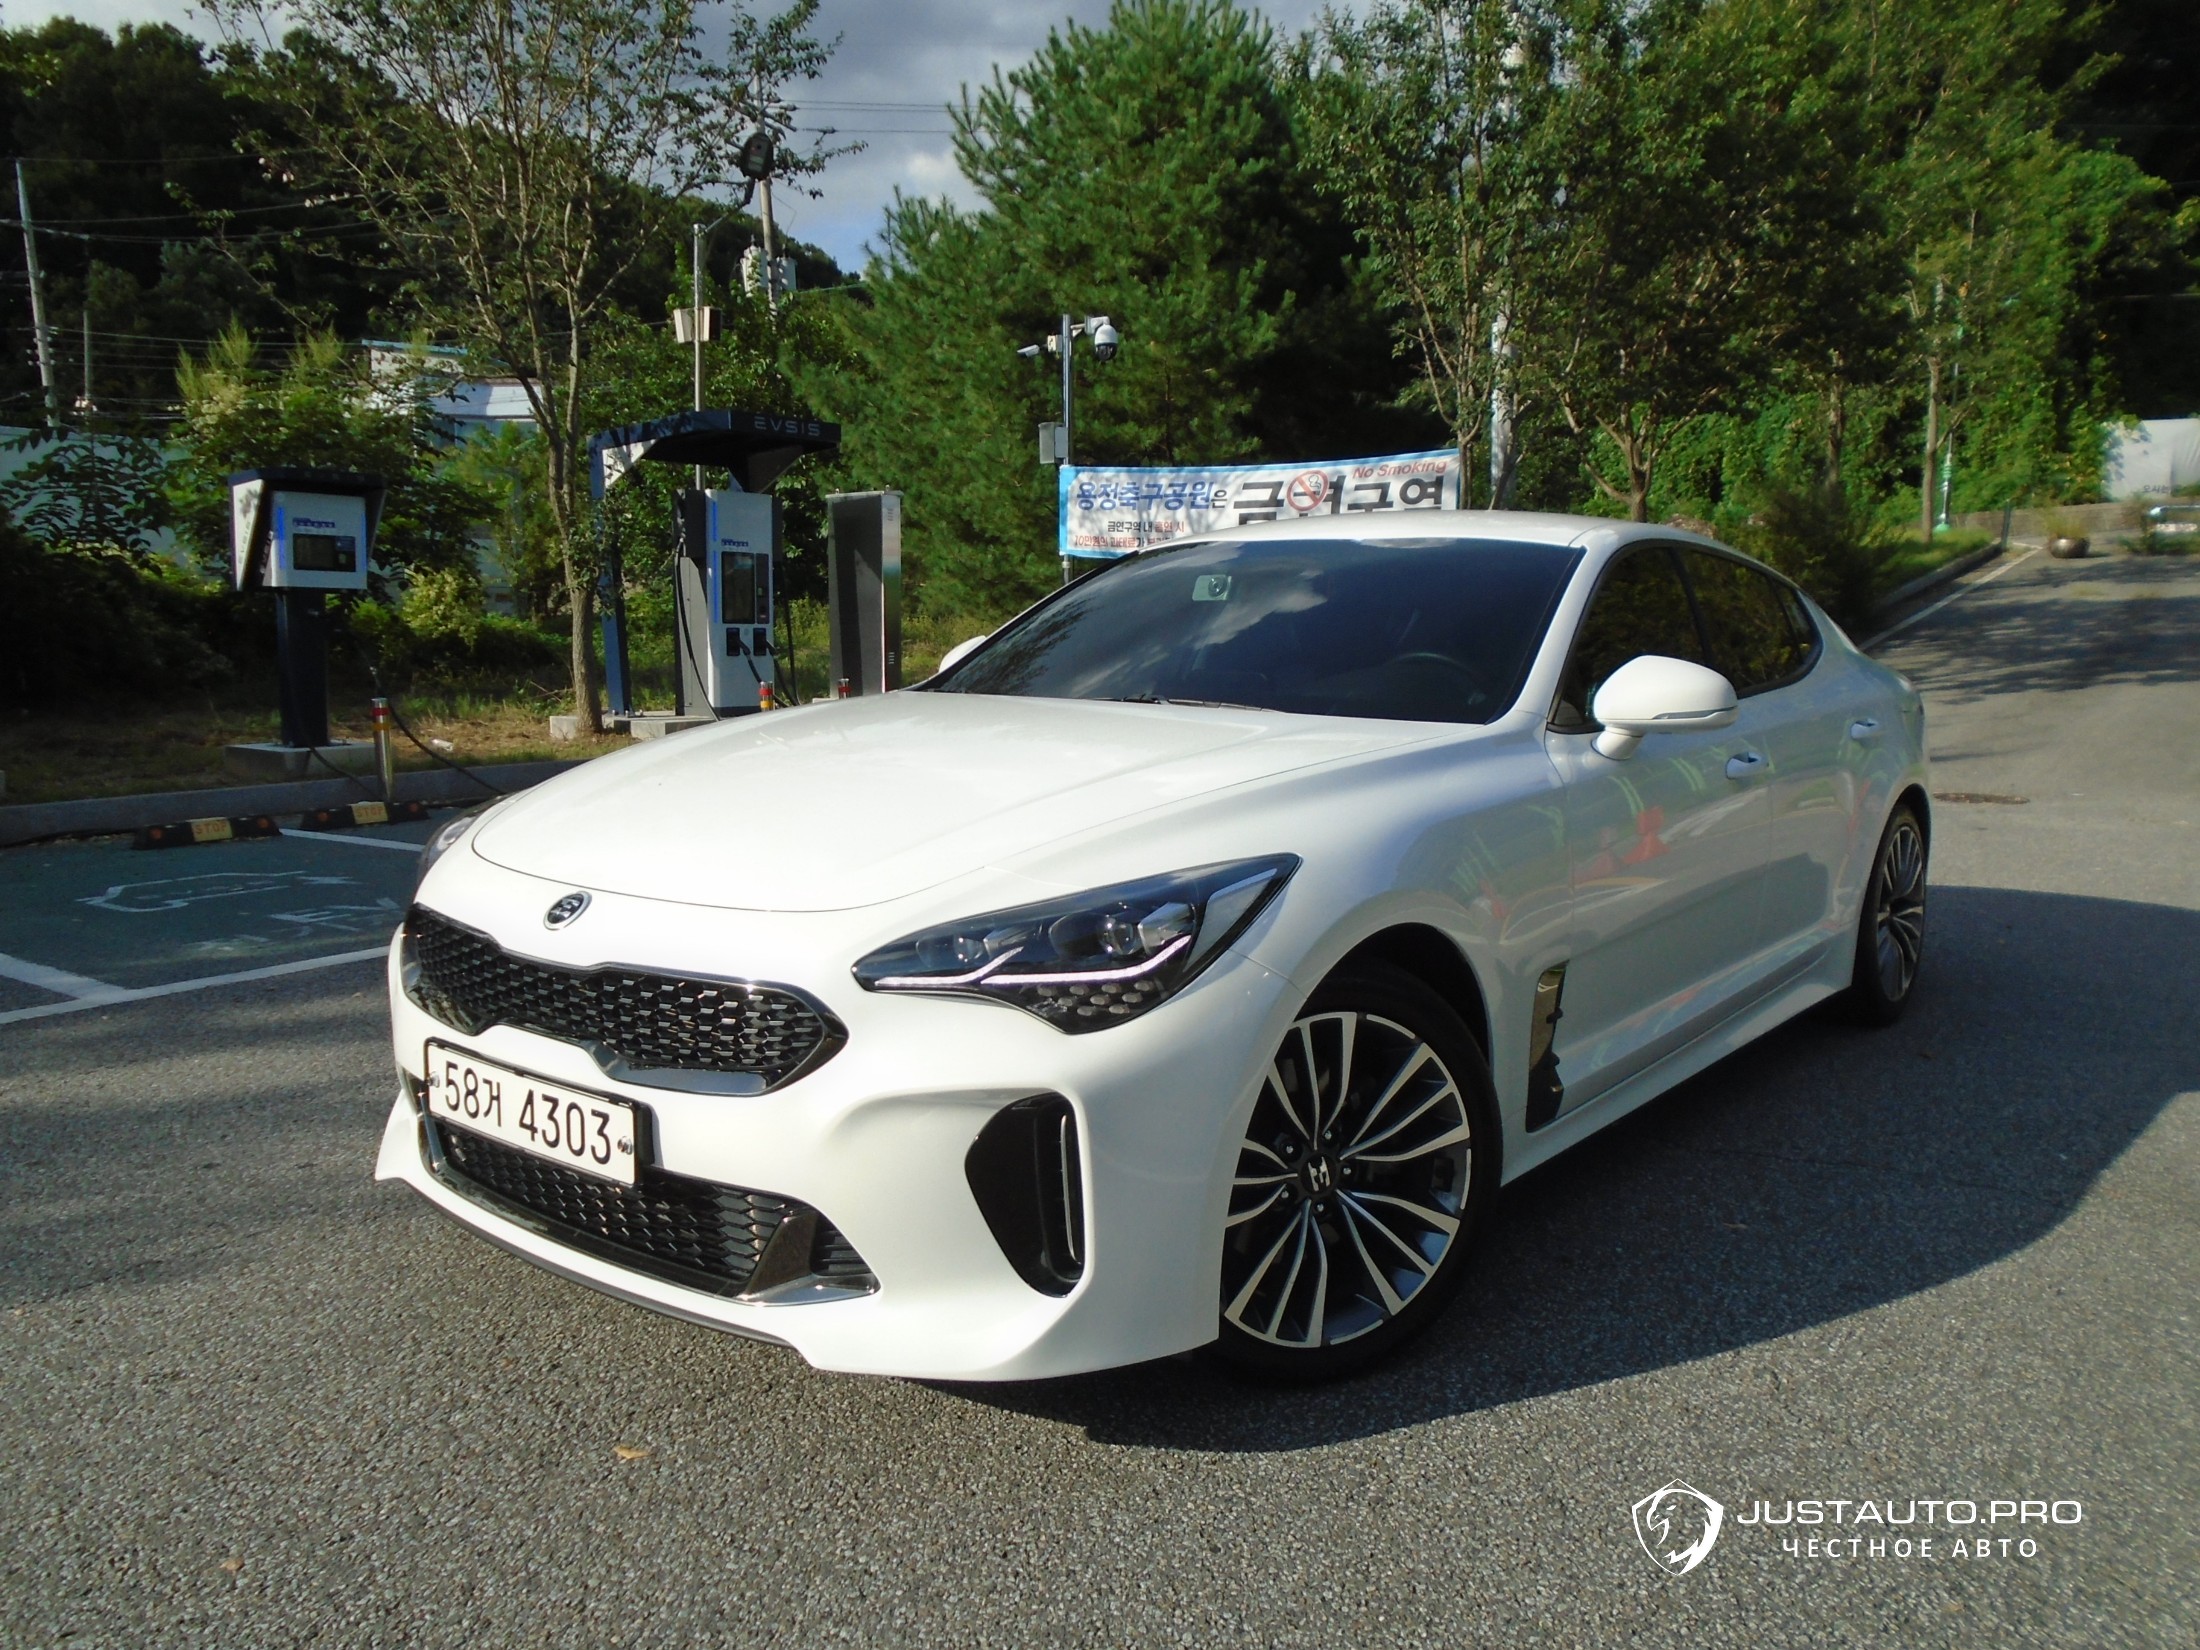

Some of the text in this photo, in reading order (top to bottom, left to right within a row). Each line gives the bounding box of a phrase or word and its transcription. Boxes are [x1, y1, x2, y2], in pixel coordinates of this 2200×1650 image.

[753, 415, 821, 436] EVSIS
[1352, 460, 1447, 479] No Smoking
[1076, 481, 1228, 511] 용정축구공원은
[1107, 521, 1141, 533] 금연구역
[356, 806, 385, 818] STOP
[194, 822, 228, 835] STOP
[444, 1060, 612, 1165] 58거 4303
